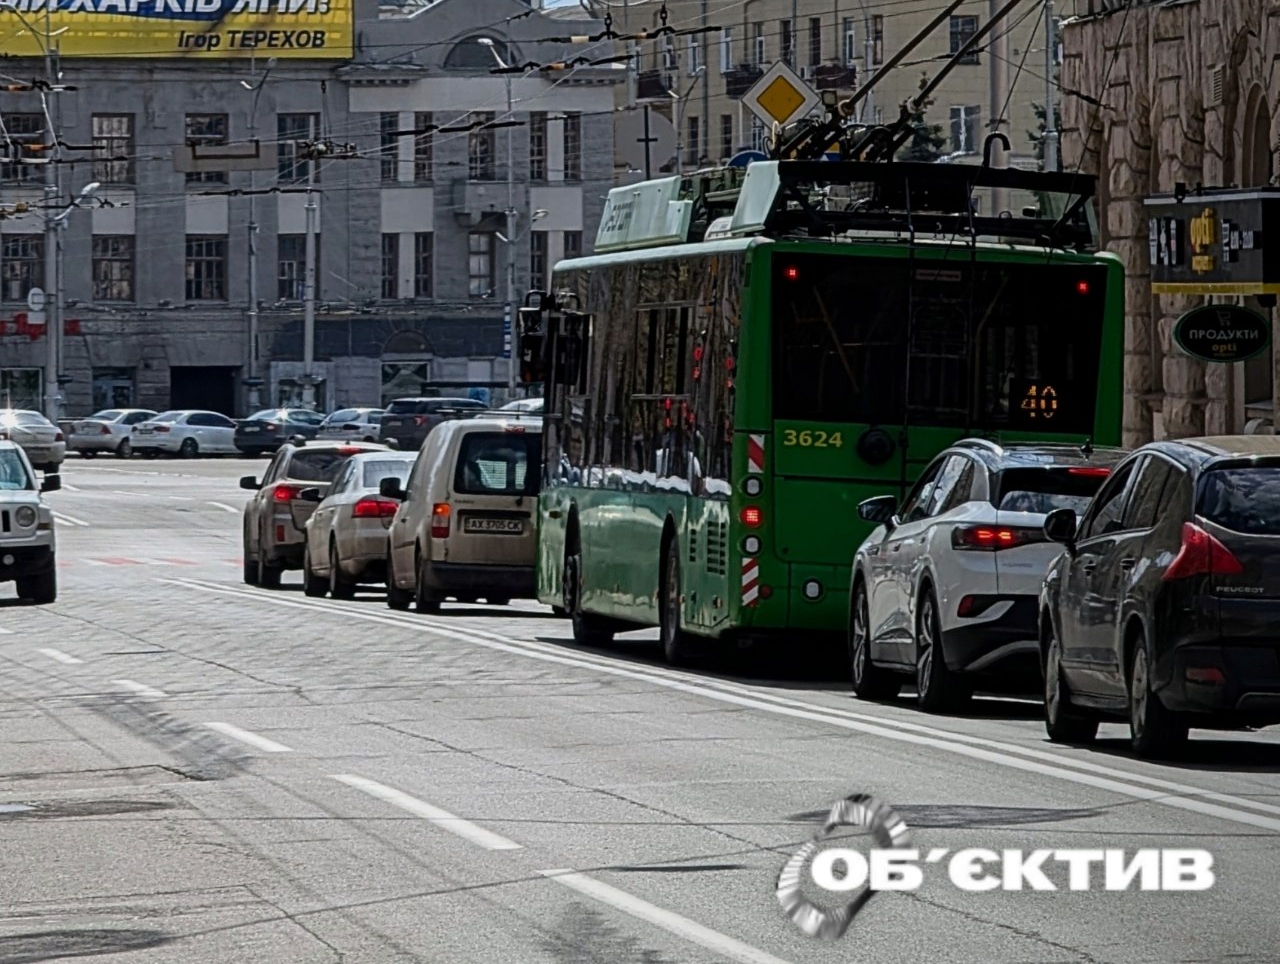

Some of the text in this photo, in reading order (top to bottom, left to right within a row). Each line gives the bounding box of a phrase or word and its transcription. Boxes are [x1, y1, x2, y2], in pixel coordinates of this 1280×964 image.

[178, 29, 326, 52] Ігор ТЕРЕХОВ
[1189, 329, 1259, 340] ПРОДУКТИ
[1021, 385, 1058, 418] 40
[783, 429, 843, 448] 3624
